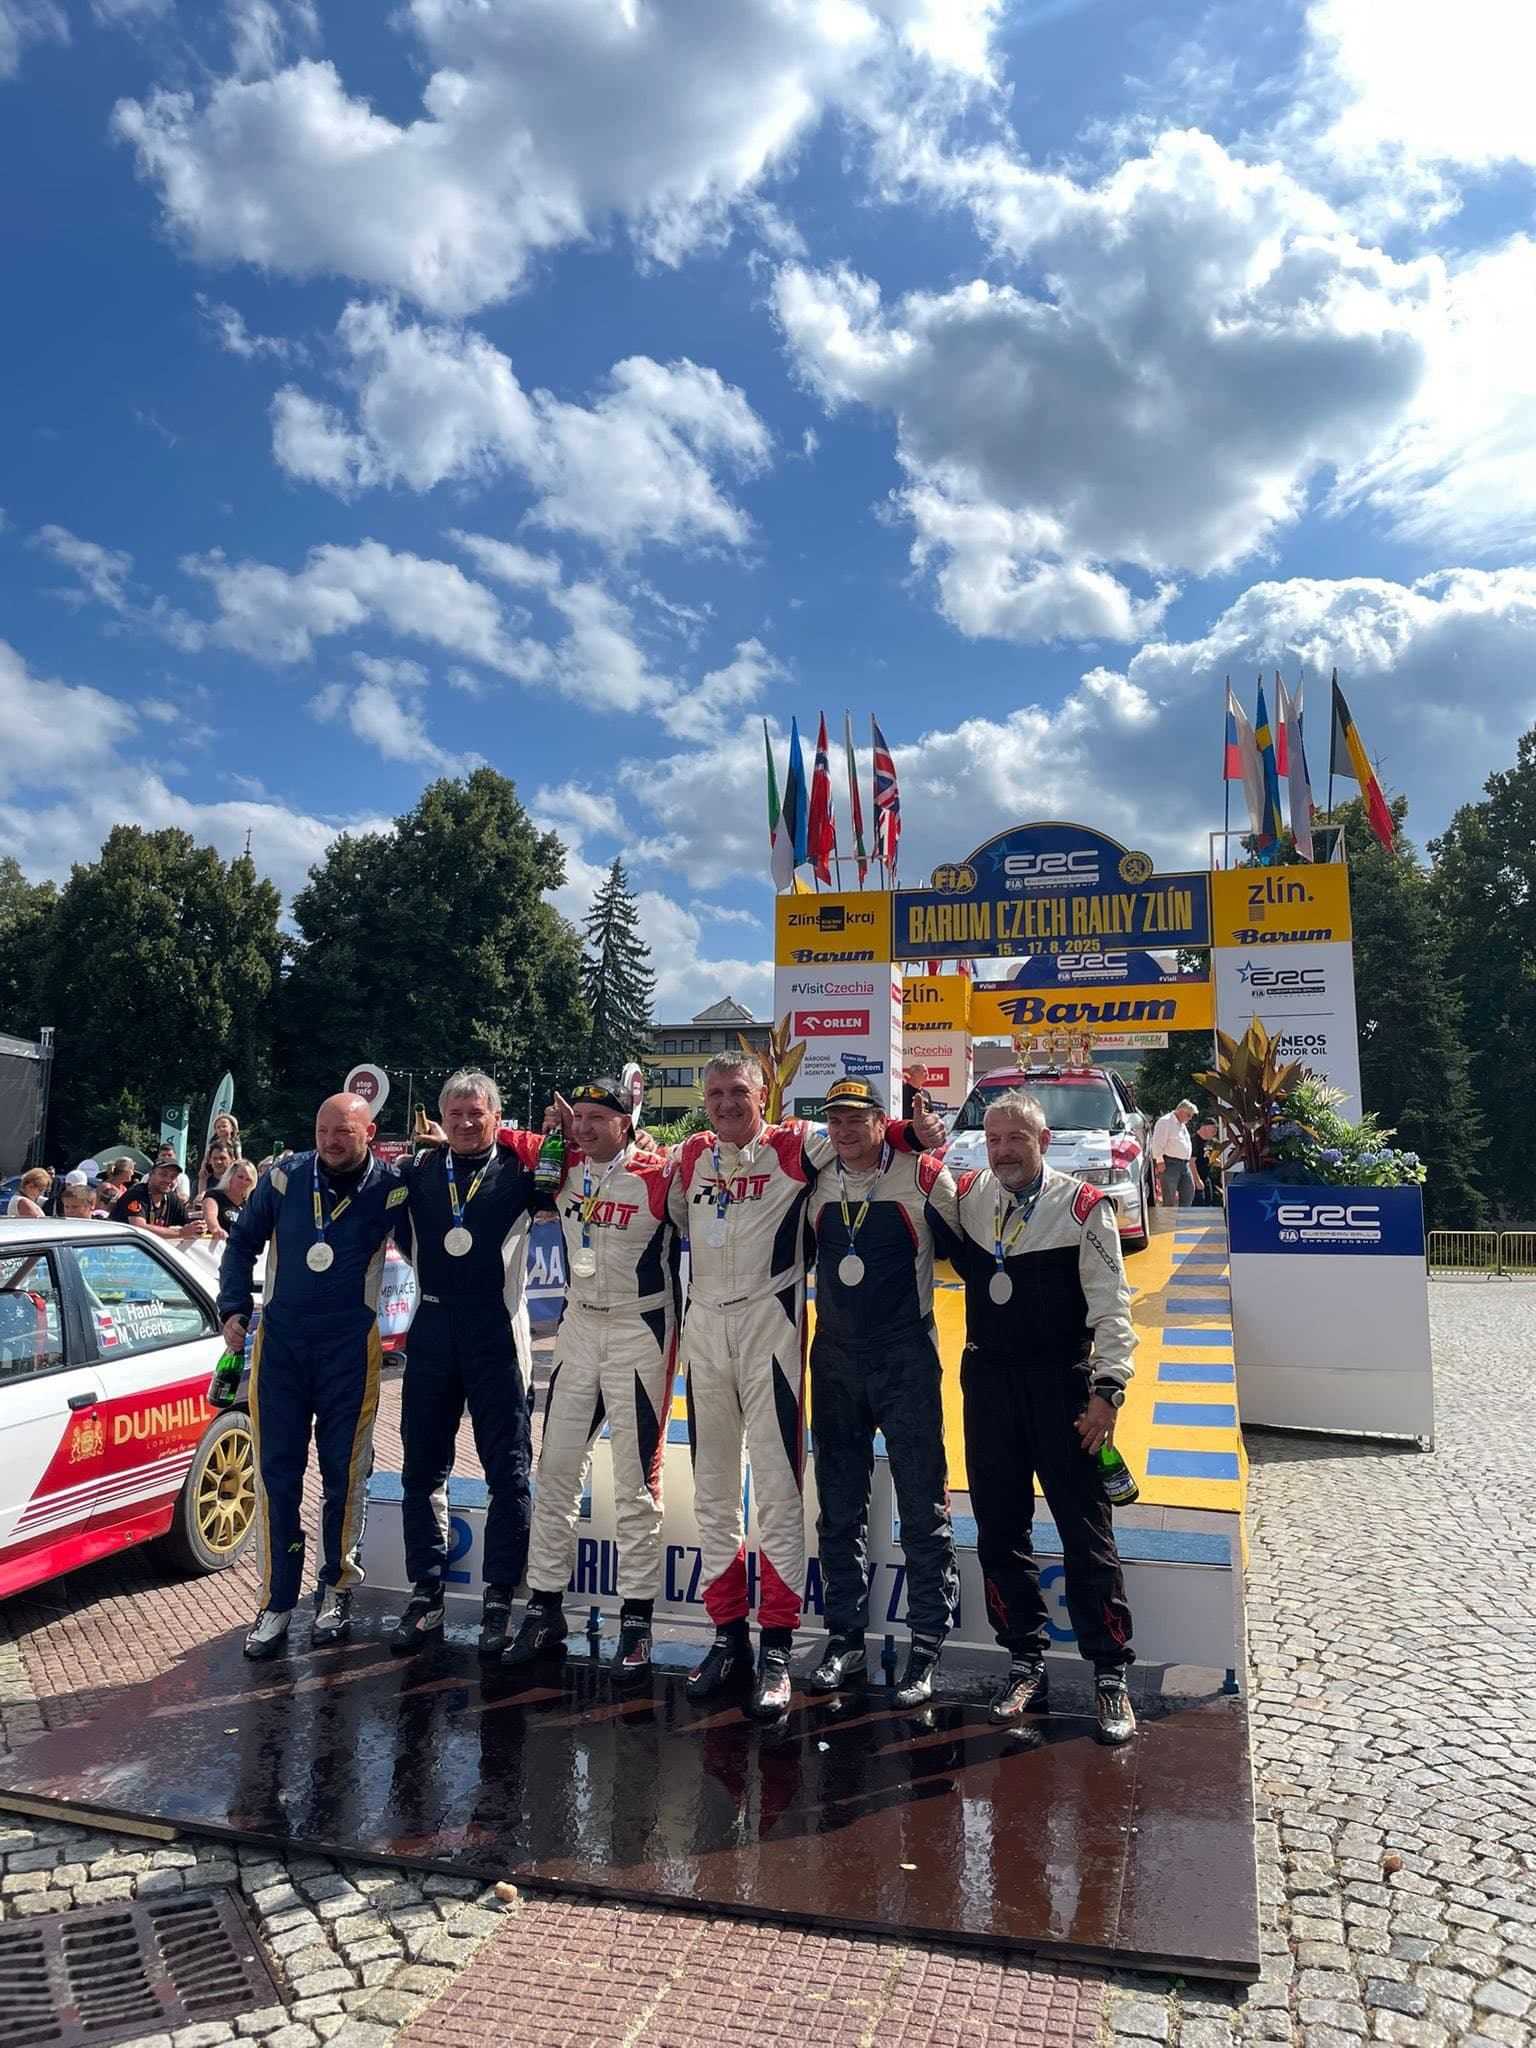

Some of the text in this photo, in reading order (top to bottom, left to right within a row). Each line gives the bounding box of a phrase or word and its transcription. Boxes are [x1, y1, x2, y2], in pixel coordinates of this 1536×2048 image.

[1004, 850, 1099, 875] ERC
[935, 870, 973, 890] FIA
[1005, 878, 1023, 890] FIA
[1247, 876, 1314, 905] zlín.
[846, 910, 875, 925] kraj
[909, 885, 1193, 944] BARUM CZECH RALLY ZLÍN
[1232, 928, 1332, 944] Barum
[790, 948, 875, 964] Barum
[996, 943, 1015, 956] 15.
[1028, 941, 1047, 954] 17.
[1065, 939, 1100, 953] 2025
[1057, 951, 1128, 970] ERC
[1250, 968, 1325, 986] ERC
[997, 996, 1177, 1025] Barum
[823, 1018, 862, 1028] ORLEN
[1311, 1047, 1328, 1055] OIL
[848, 1065, 881, 1073] sportem
[1278, 1205, 1380, 1226] ERC
[1280, 1230, 1298, 1242] FIA
[115, 1300, 165, 1324] J. Hanák
[118, 1328, 133, 1344] M.
[114, 1394, 211, 1445] DUNHILL
